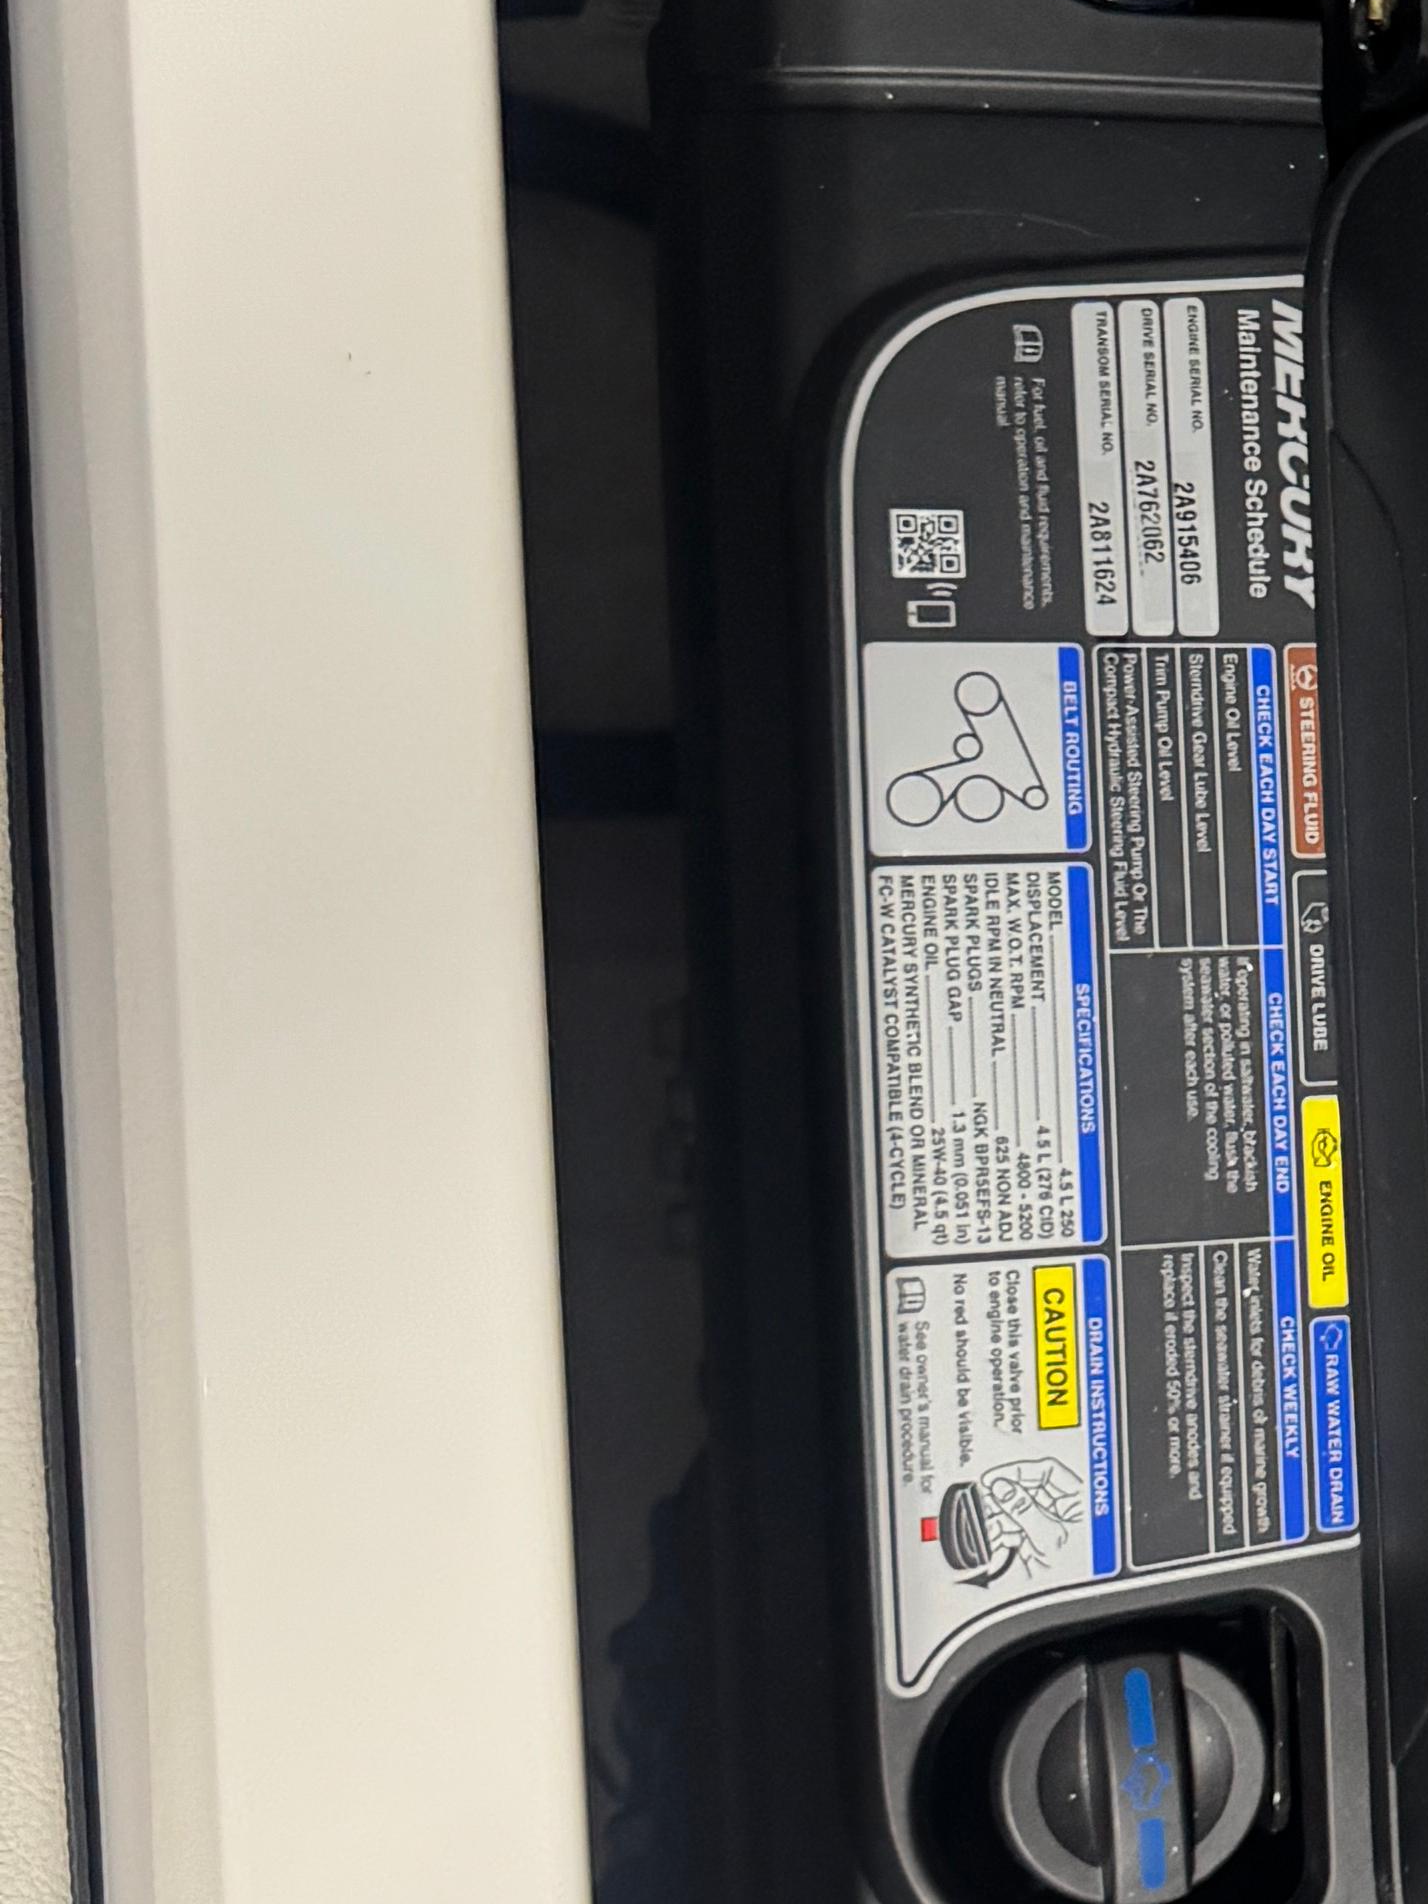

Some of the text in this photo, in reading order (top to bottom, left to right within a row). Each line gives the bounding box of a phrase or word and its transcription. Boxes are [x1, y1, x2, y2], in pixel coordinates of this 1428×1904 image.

[1096, 310, 1114, 455] TRANSOM SERIAL NO.
[1140, 307, 1158, 426] DRIVE SERIAL NO.
[1186, 304, 1204, 433] ENGINE SERIAL NO.
[1134, 460, 1165, 564] 2A762062
[1238, 308, 1270, 598] Maintenance Schedule
[1088, 501, 1116, 605] 2A811624
[1171, 481, 1201, 585] 2A915406
[1063, 680, 1082, 815] BELT ROUTING
[1154, 653, 1174, 801] Trim Pump Oil Level
[1188, 653, 1212, 852] Sterndrive Gear Lube Level
[1220, 653, 1242, 772] Engine Oil Level
[1300, 696, 1320, 844] STEERING FLUID
[1103, 652, 1130, 941] Compact Hydraulic Steering Fluid Level
[1123, 652, 1149, 935] Power-Assisted Steering Pump Or The
[1256, 684, 1279, 905] CHECK EACH DAY START
[900, 874, 917, 958] MERCURY
[1026, 871, 1045, 1002] DISPLACEMENT
[878, 874, 906, 1210] FC-W CATALYST COMPATIBLE (4-CYCLE)
[921, 874, 950, 1246] ENGINE OIL 25W-40 (4.5 qt)
[942, 873, 971, 1245] SPARK PLUG GAP 1.3 mm (0.051 in)
[963, 872, 992, 1244] SPARK PLUGS NGK BPR5EFS-13
[984, 872, 1013, 1242] IDLE RPM IN NEUTRAL 625 NON ADJ
[1006, 872, 1034, 1241] MAX. W.O.T. RPM 4800 5200
[1047, 871, 1075, 1238] MODEL 4.5 L 250
[1076, 983, 1095, 1134] SPECIFICATIONS
[1309, 943, 1328, 1051] DRIVE LUBE
[907, 1062, 924, 1120] BLEND
[909, 1124, 926, 1150] OR
[1036, 1152, 1052, 1163] L
[1268, 992, 1290, 1194] CHECK EACH DAY END
[912, 1154, 928, 1231] MINERAL
[1035, 1167, 1053, 1201] (276
[1037, 1204, 1055, 1239] CID)
[1319, 1180, 1335, 1282] ENGINE OIL
[897, 1321, 914, 1487] water drain procedure.
[914, 1320, 935, 1494] See owner's manual for
[953, 1272, 973, 1467] No red should be visible.
[986, 1270, 1008, 1428] to engine operation.
[1003, 1269, 1025, 1434] Close this valve prior
[1043, 1287, 1068, 1406] CAUTION
[1088, 1317, 1108, 1517] DRAIN INSTRUCTIONS
[1178, 1252, 1203, 1500] Inspect the sterndrive anodes and
[1280, 1315, 1299, 1458] CHECK WEEKLY
[1325, 1354, 1344, 1525] RAW WATER DRAIN
